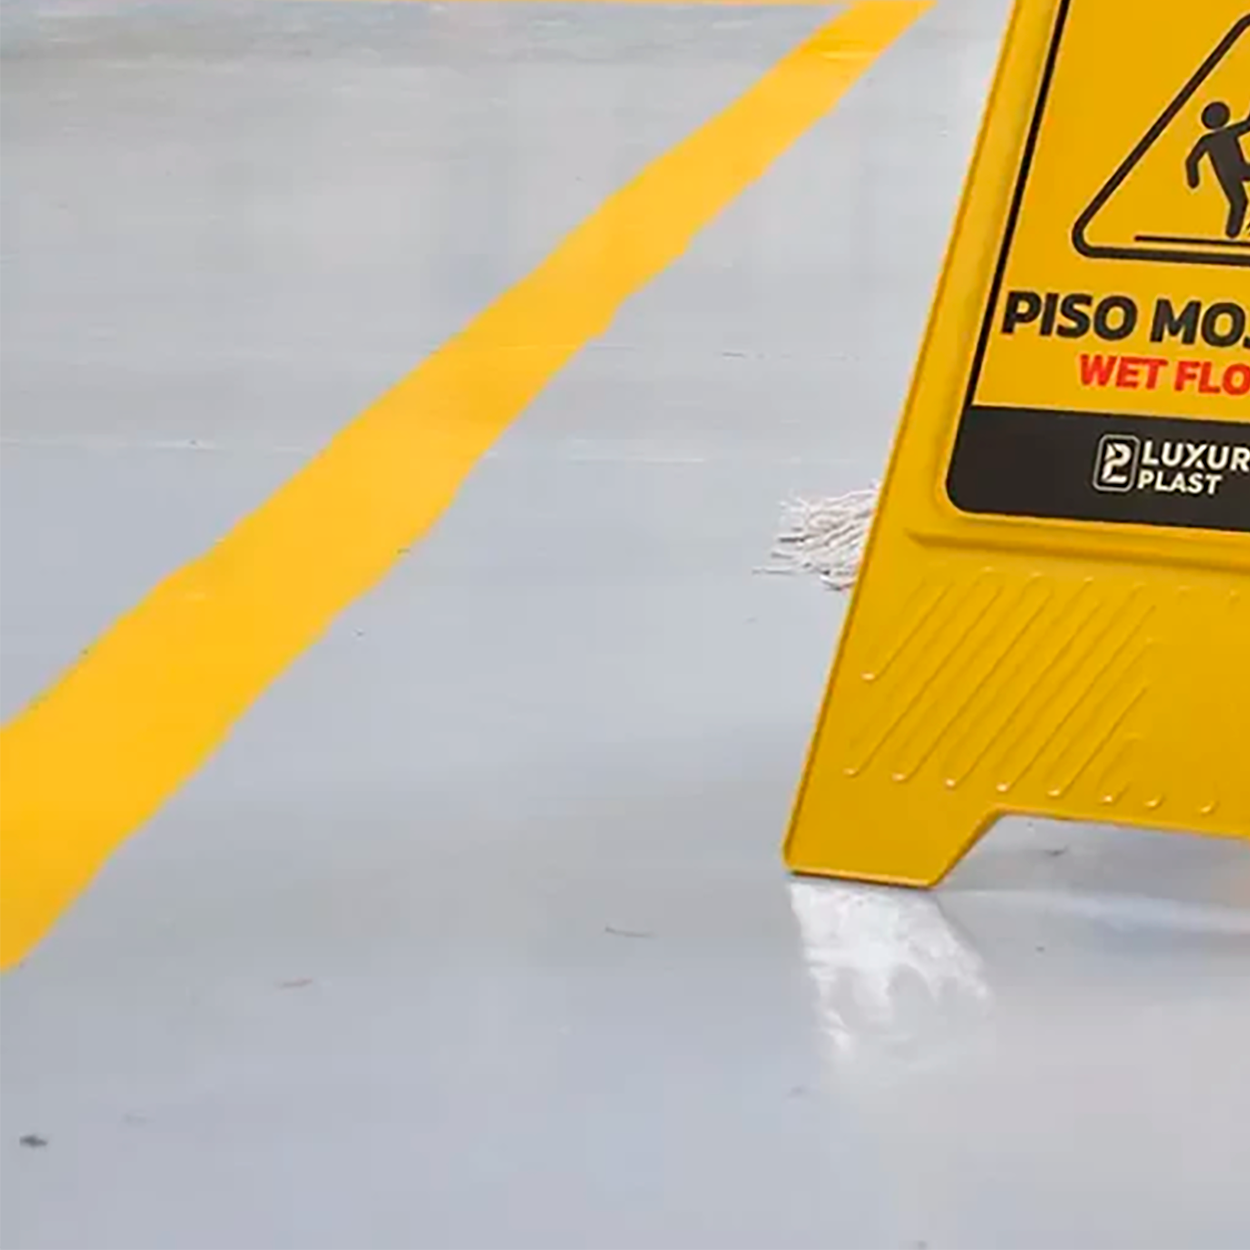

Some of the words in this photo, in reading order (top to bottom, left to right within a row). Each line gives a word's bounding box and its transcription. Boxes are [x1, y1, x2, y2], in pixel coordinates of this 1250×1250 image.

[1001, 290, 1139, 342] PISO
[1080, 353, 1169, 390] WET
[1137, 469, 1224, 495] PLAST
